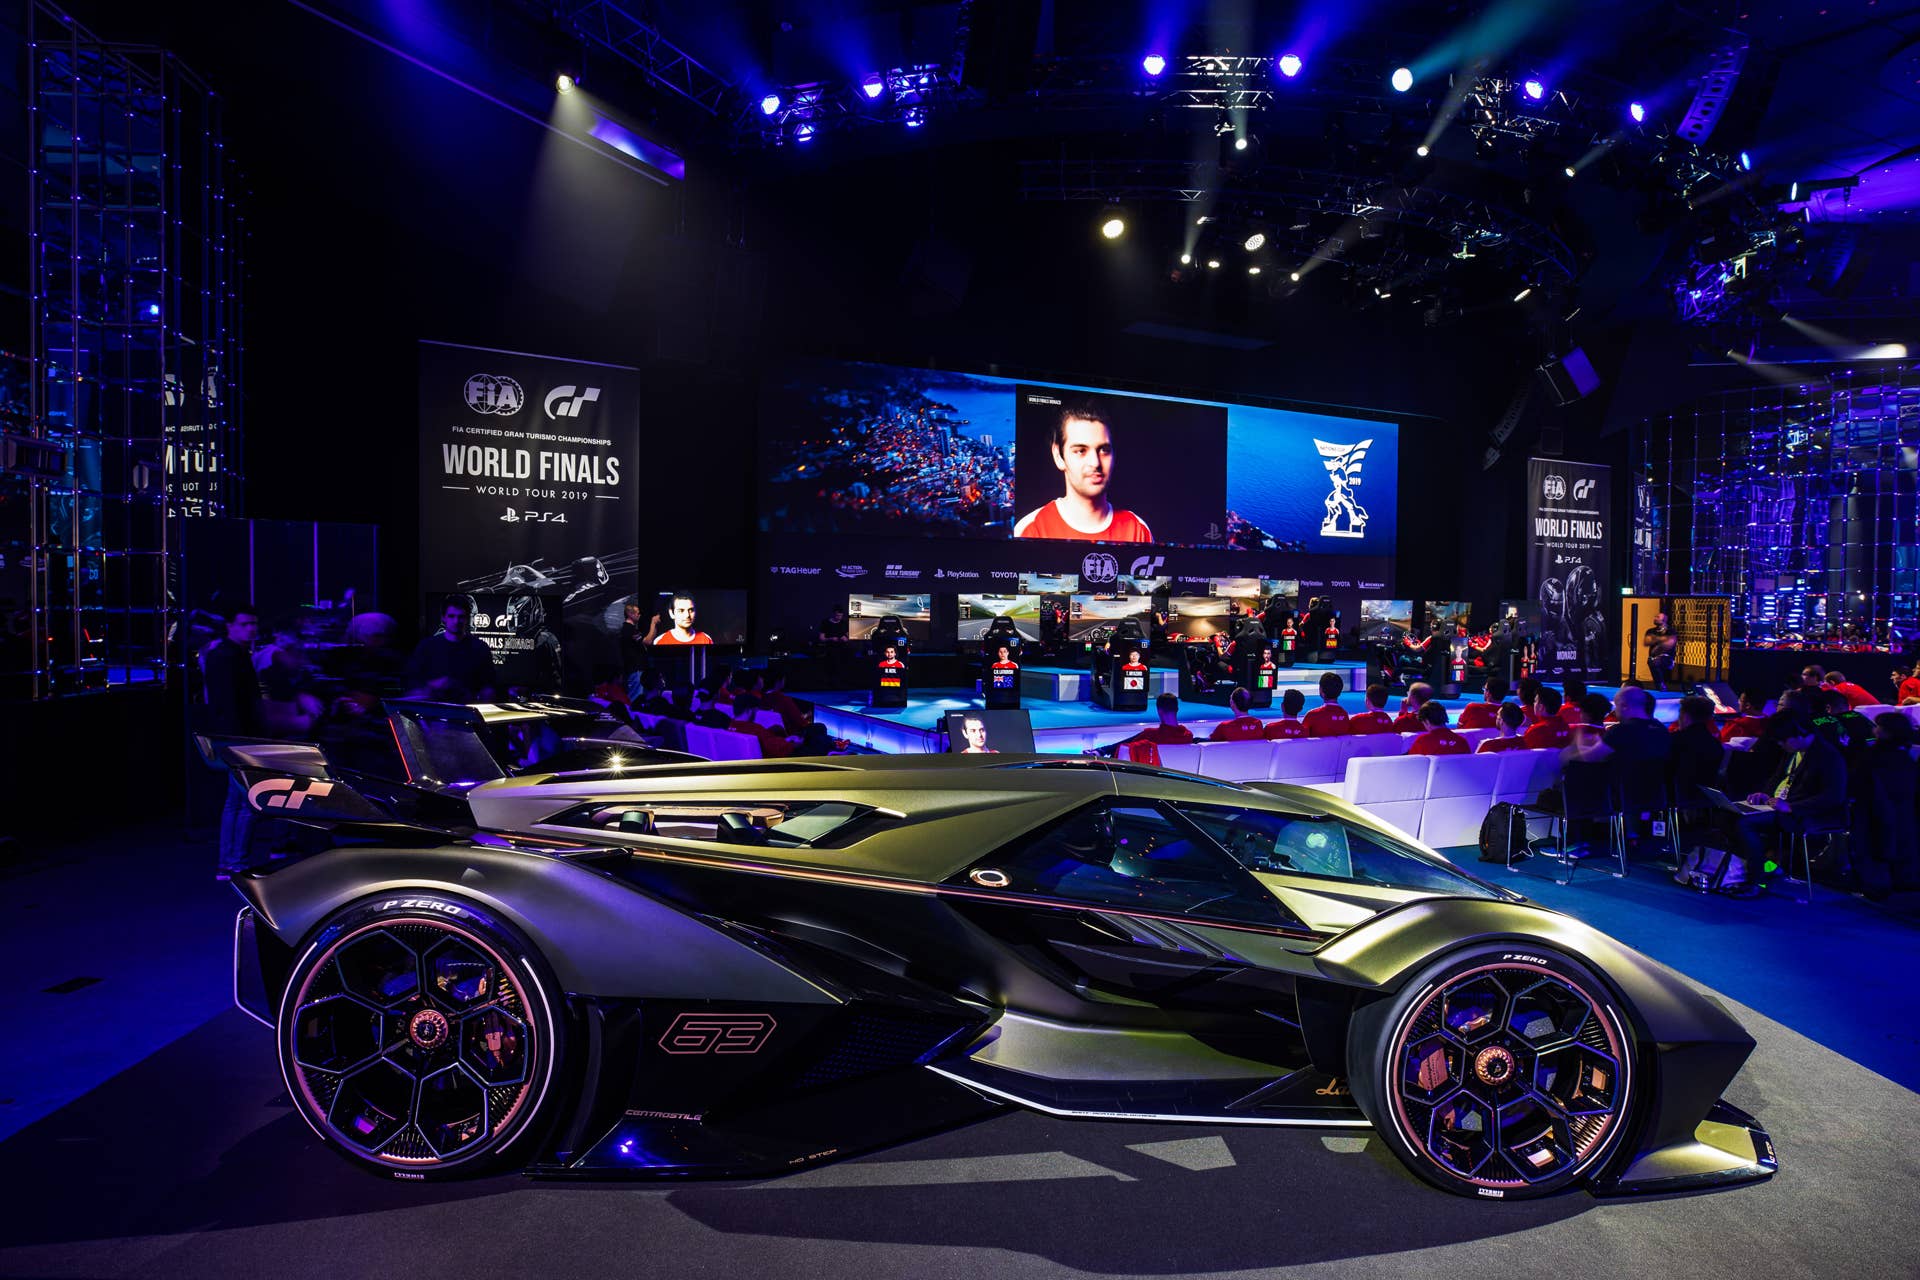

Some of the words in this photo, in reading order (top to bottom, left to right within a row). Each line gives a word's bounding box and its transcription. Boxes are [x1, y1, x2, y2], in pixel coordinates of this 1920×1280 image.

[466, 380, 519, 410] FIA
[452, 425, 464, 433] FIA
[465, 427, 502, 437] CERTIFIED
[504, 430, 524, 438] GRAN
[526, 432, 557, 441] TURISMO
[558, 435, 612, 446] CHAMPIONSHIPS
[442, 443, 531, 479] WORLD
[540, 451, 620, 486] FINALS
[476, 485, 519, 497] WORLD
[525, 488, 556, 499] TOUR
[561, 491, 588, 501] 2019
[1543, 478, 1565, 497] FIA
[525, 511, 566, 523] PS4
[1535, 517, 1568, 538] WORLD
[1570, 519, 1602, 540] FINALS
[1564, 556, 1582, 564] PS4
[947, 570, 979, 579] PlayStation
[991, 571, 1018, 579] TOYOTA
[1085, 558, 1116, 579] FIA
[474, 614, 490, 628] FIA
[479, 636, 503, 649] NALS
[504, 638, 535, 650] MONACO
[1556, 650, 1577, 661] MONACO
[383, 900, 398, 910] P
[401, 899, 461, 914] ZERO
[1513, 954, 1548, 965] ZERO
[658, 1013, 777, 1054] 63
